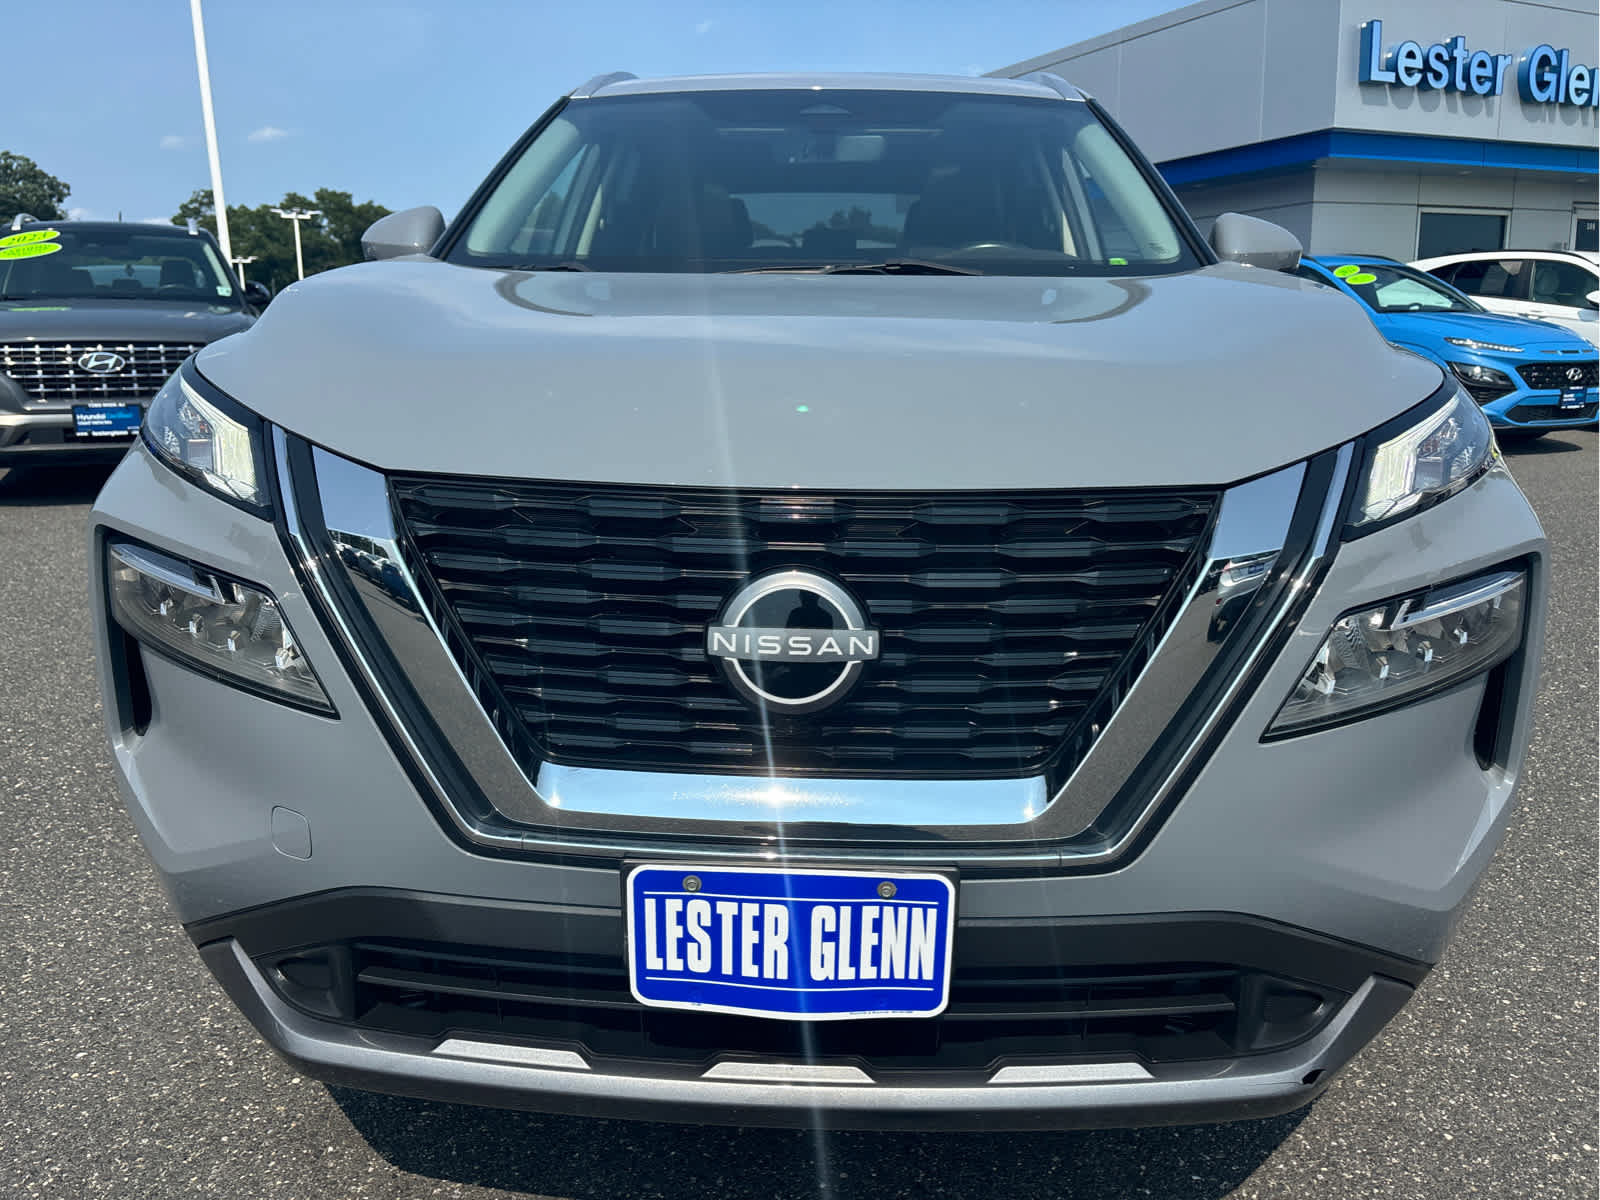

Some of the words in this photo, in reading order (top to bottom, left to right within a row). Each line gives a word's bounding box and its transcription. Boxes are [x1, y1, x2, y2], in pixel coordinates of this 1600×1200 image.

[1360, 19, 1512, 96] Lester
[713, 632, 873, 656] NISSAN
[644, 898, 789, 980] LESTER
[810, 905, 938, 982] GLENN
